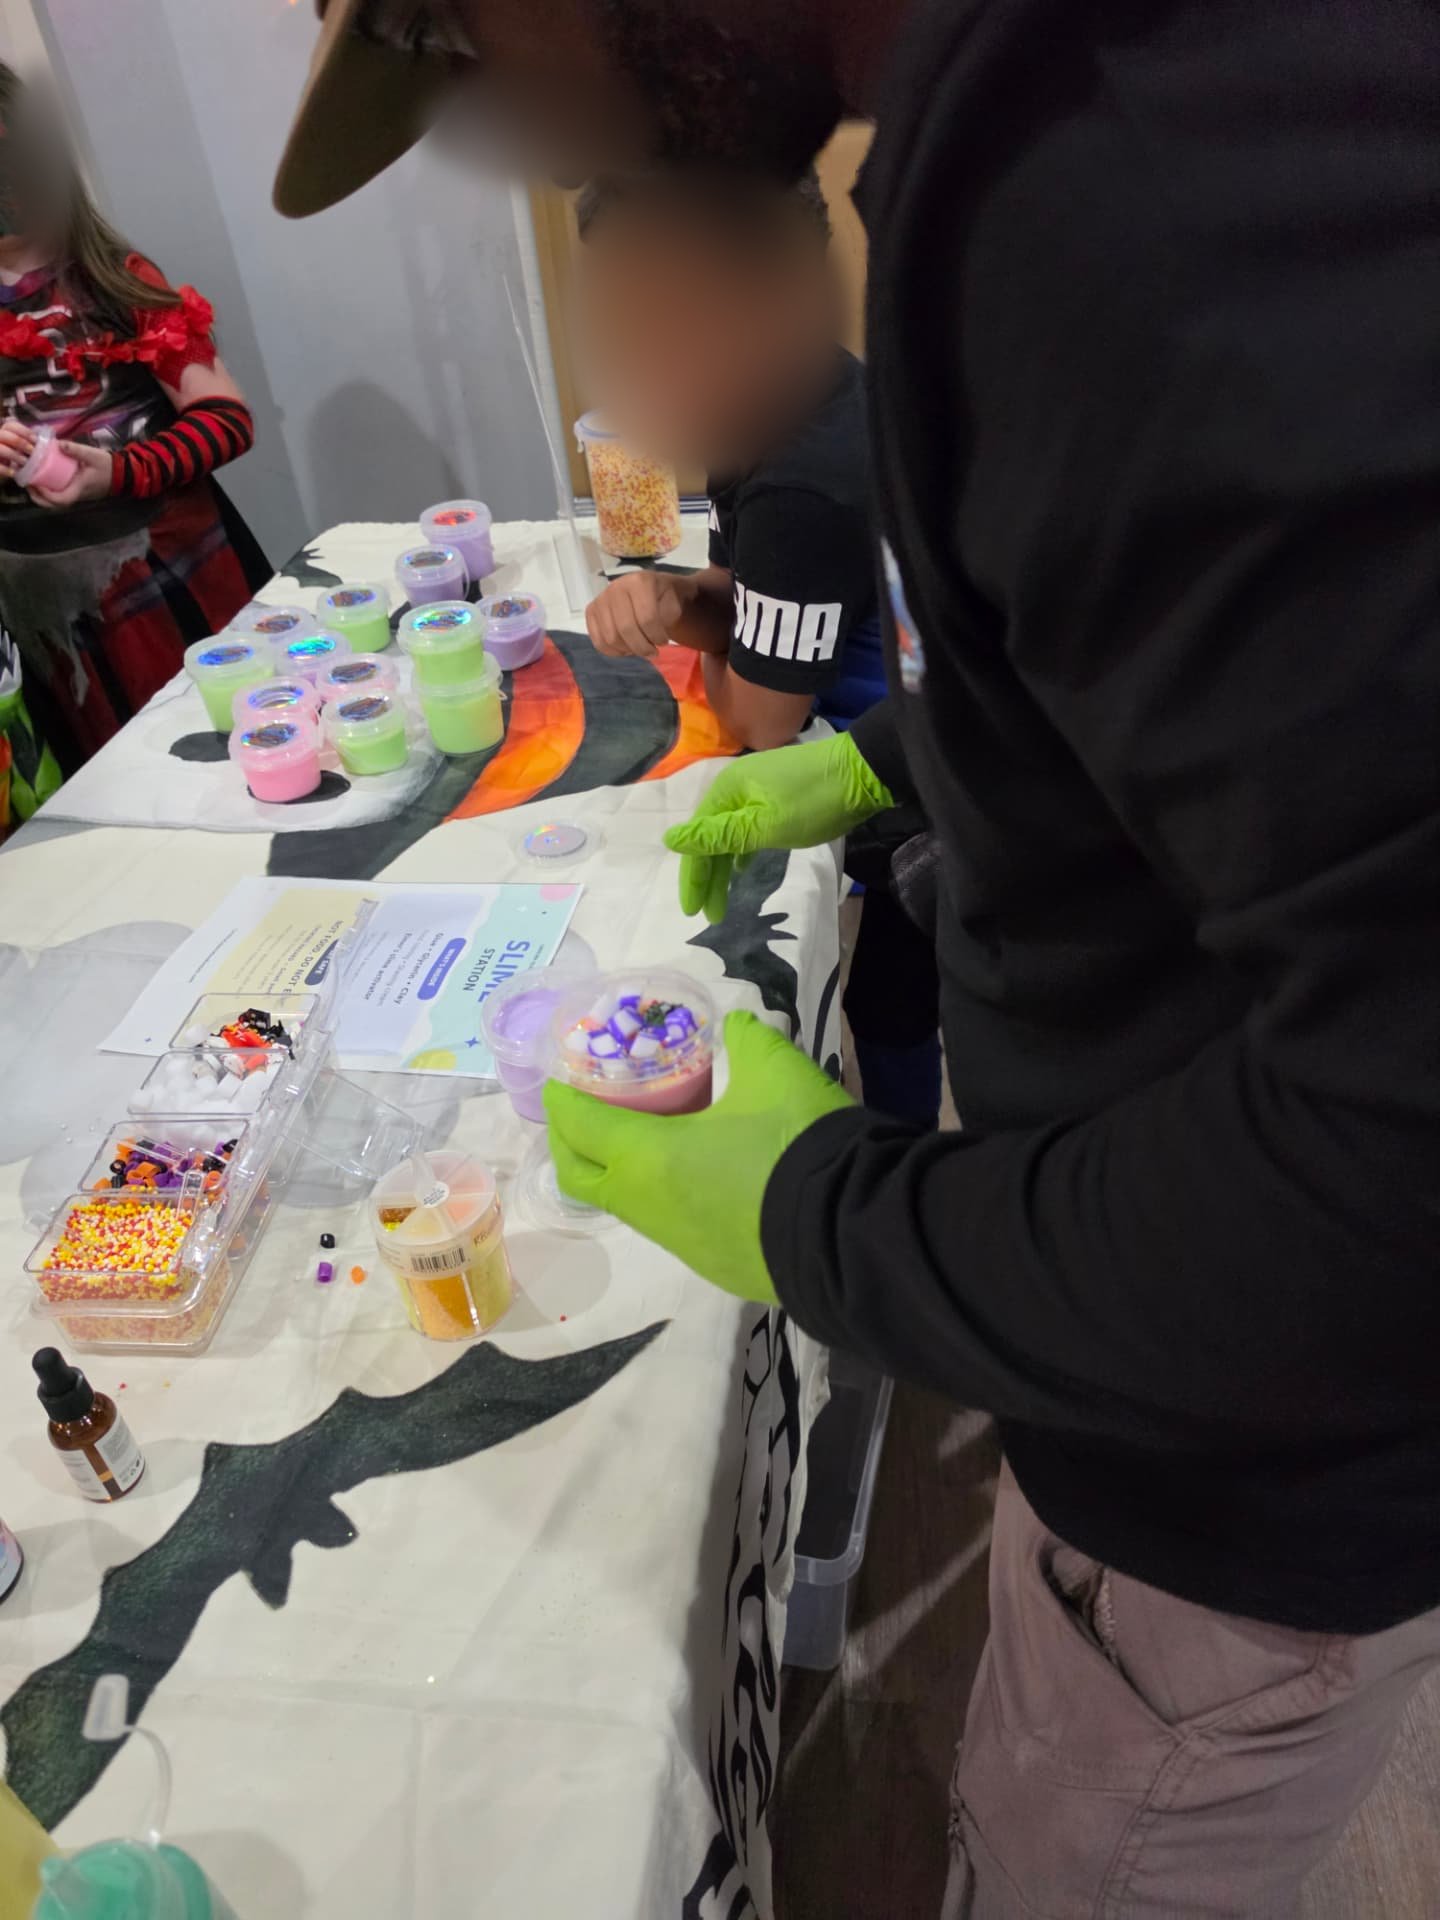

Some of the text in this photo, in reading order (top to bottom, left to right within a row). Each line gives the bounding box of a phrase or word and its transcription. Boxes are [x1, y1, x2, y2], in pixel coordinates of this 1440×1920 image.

[734, 581, 843, 662] MA
[301, 956, 314, 968] DO
[463, 948, 496, 991] STATION
[288, 969, 305, 986] NOT
[393, 987, 409, 1005] Clay
